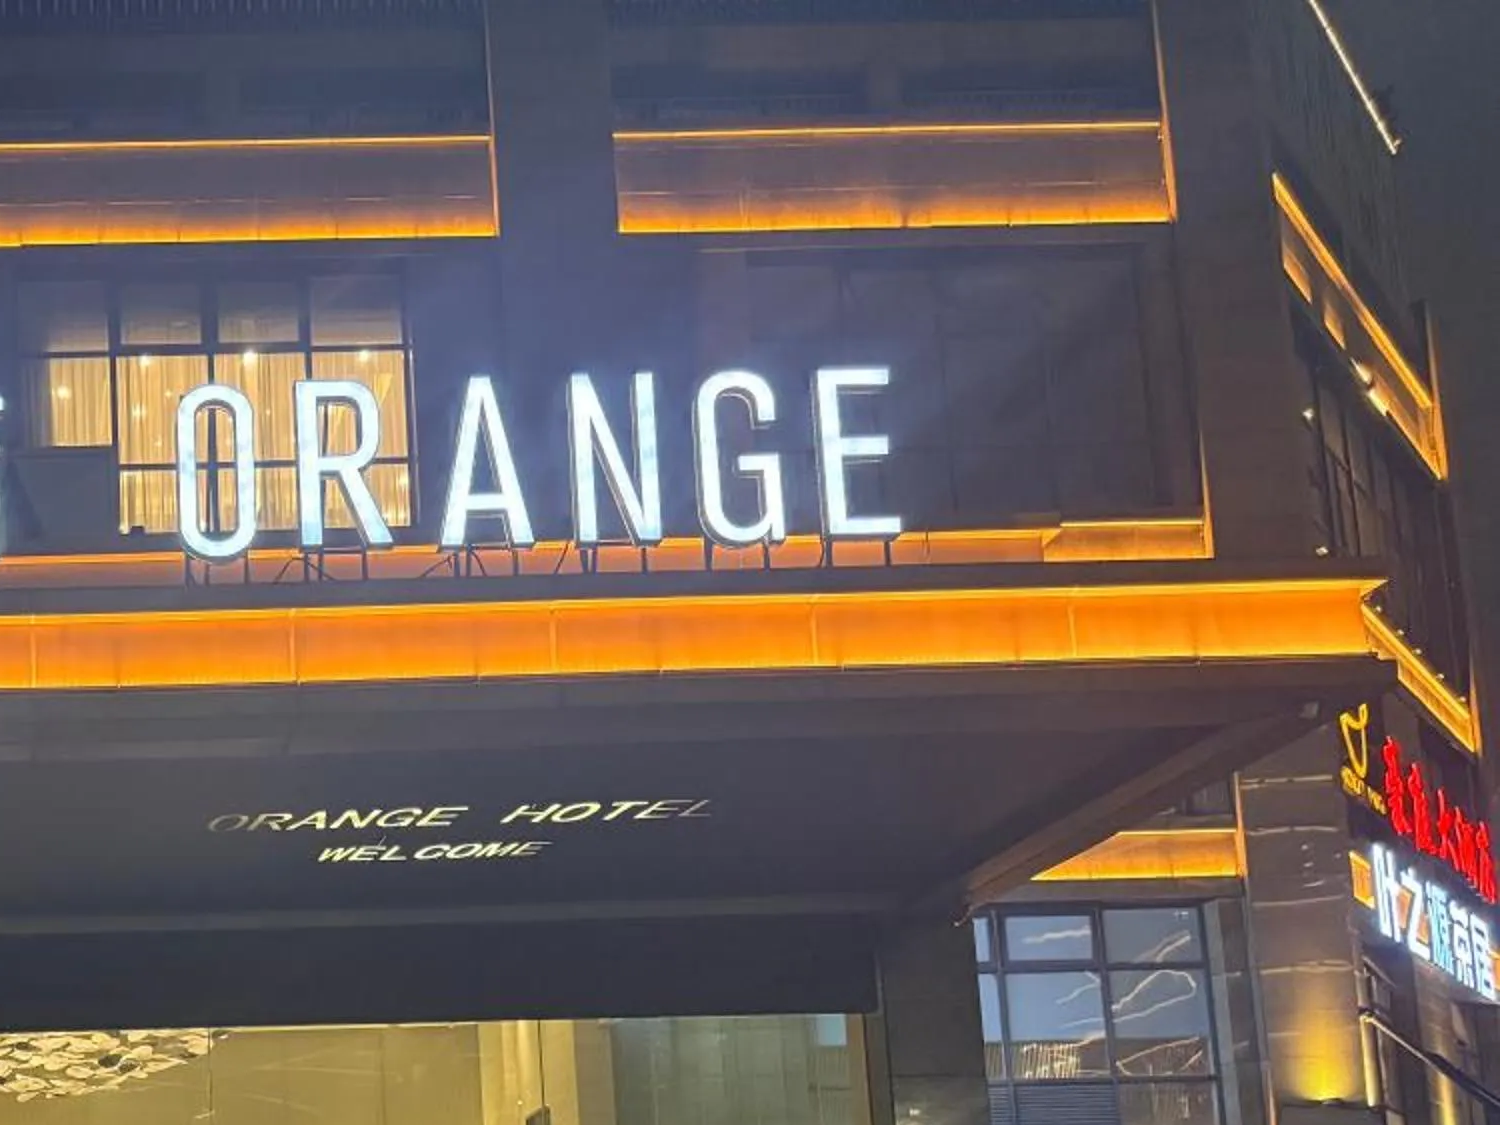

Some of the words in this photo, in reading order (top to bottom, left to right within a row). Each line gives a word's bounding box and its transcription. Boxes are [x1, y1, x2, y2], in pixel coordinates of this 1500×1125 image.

[176, 364, 903, 563] ORANGE
[206, 805, 470, 833] ORANGE
[500, 799, 714, 824] HOTEL
[317, 840, 553, 863] WELCOME
